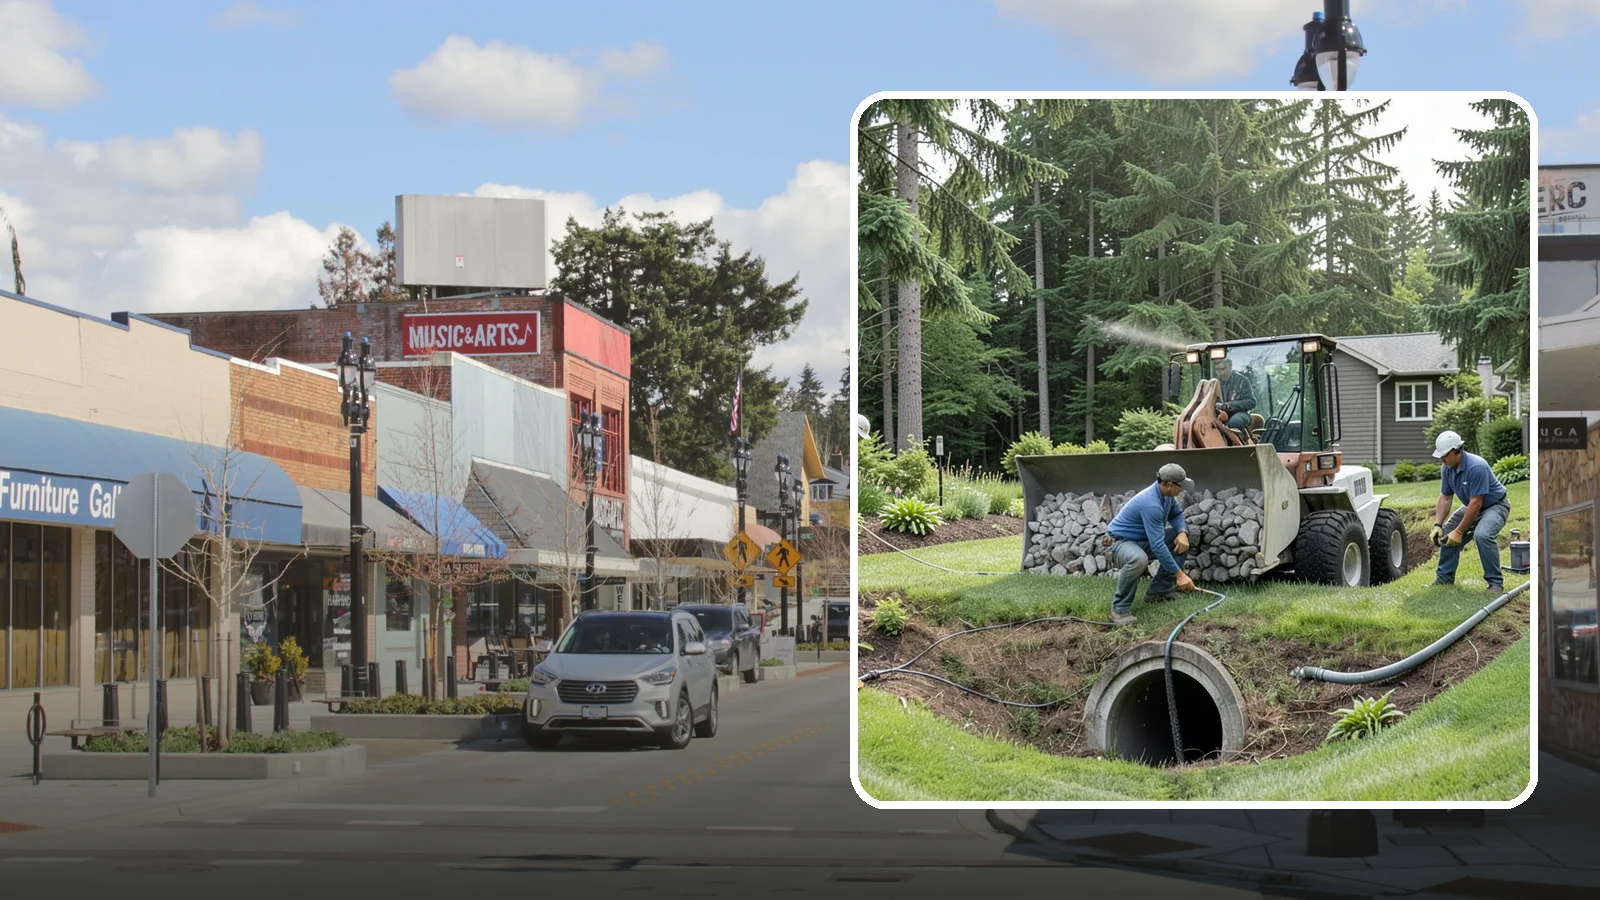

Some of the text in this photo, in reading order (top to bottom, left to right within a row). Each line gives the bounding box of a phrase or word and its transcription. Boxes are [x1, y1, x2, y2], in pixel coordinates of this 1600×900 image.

[409, 323, 519, 349] MUSIC&ARTS
[0, 471, 79, 515] Furniture
[453, 563, 480, 574] SUSHI
